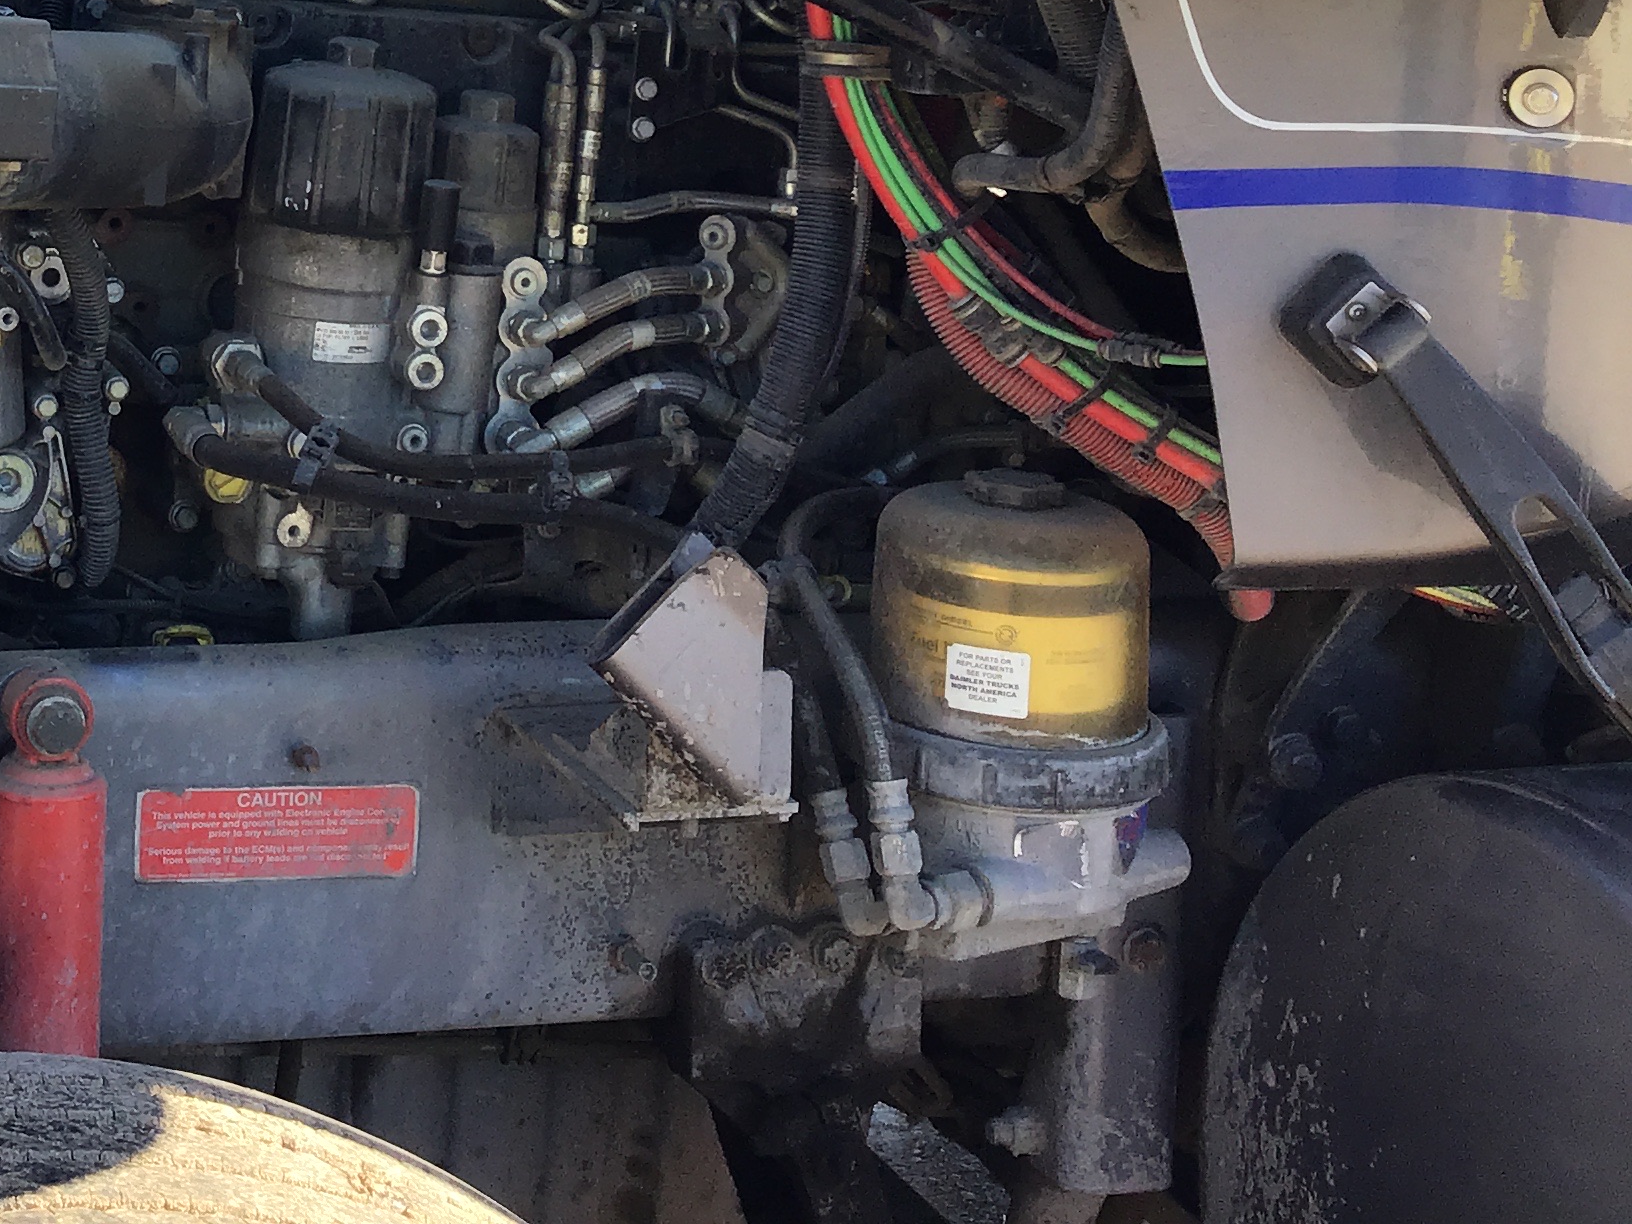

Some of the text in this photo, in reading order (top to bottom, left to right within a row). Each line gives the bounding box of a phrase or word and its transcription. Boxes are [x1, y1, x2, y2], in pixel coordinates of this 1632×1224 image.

[959, 651, 974, 660] FOR
[975, 655, 999, 664] PARTS
[956, 659, 1014, 674] REPLACEMENTS
[966, 669, 1003, 680] SEE YOUR
[949, 673, 1020, 690] DAIMLER TRUCKS
[951, 682, 1017, 698] NORTH AMERICA
[968, 694, 998, 704] DEALER
[237, 792, 322, 808] CAUTION
[152, 811, 171, 820] This
[174, 811, 206, 820] vehicle
[208, 811, 217, 819] is
[218, 810, 262, 820] equipped
[285, 808, 330, 818] Electronic
[333, 808, 365, 818] Engine
[156, 821, 190, 830] System
[192, 821, 220, 830] power
[222, 820, 240, 828] and
[242, 819, 275, 829] ground
[277, 818, 299, 826] lines
[301, 818, 325, 826] must
[327, 818, 338, 826] be
[208, 830, 231, 839] prior
[233, 829, 243, 837] to
[245, 829, 262, 838] any
[316, 827, 348, 836] vehicle
[185, 846, 221, 856] damage
[223, 846, 233, 854] to
[235, 845, 249, 854] the
[287, 844, 304, 852] and
[162, 856, 184, 865] from
[186, 856, 222, 866] welding
[267, 854, 291, 863] leads
